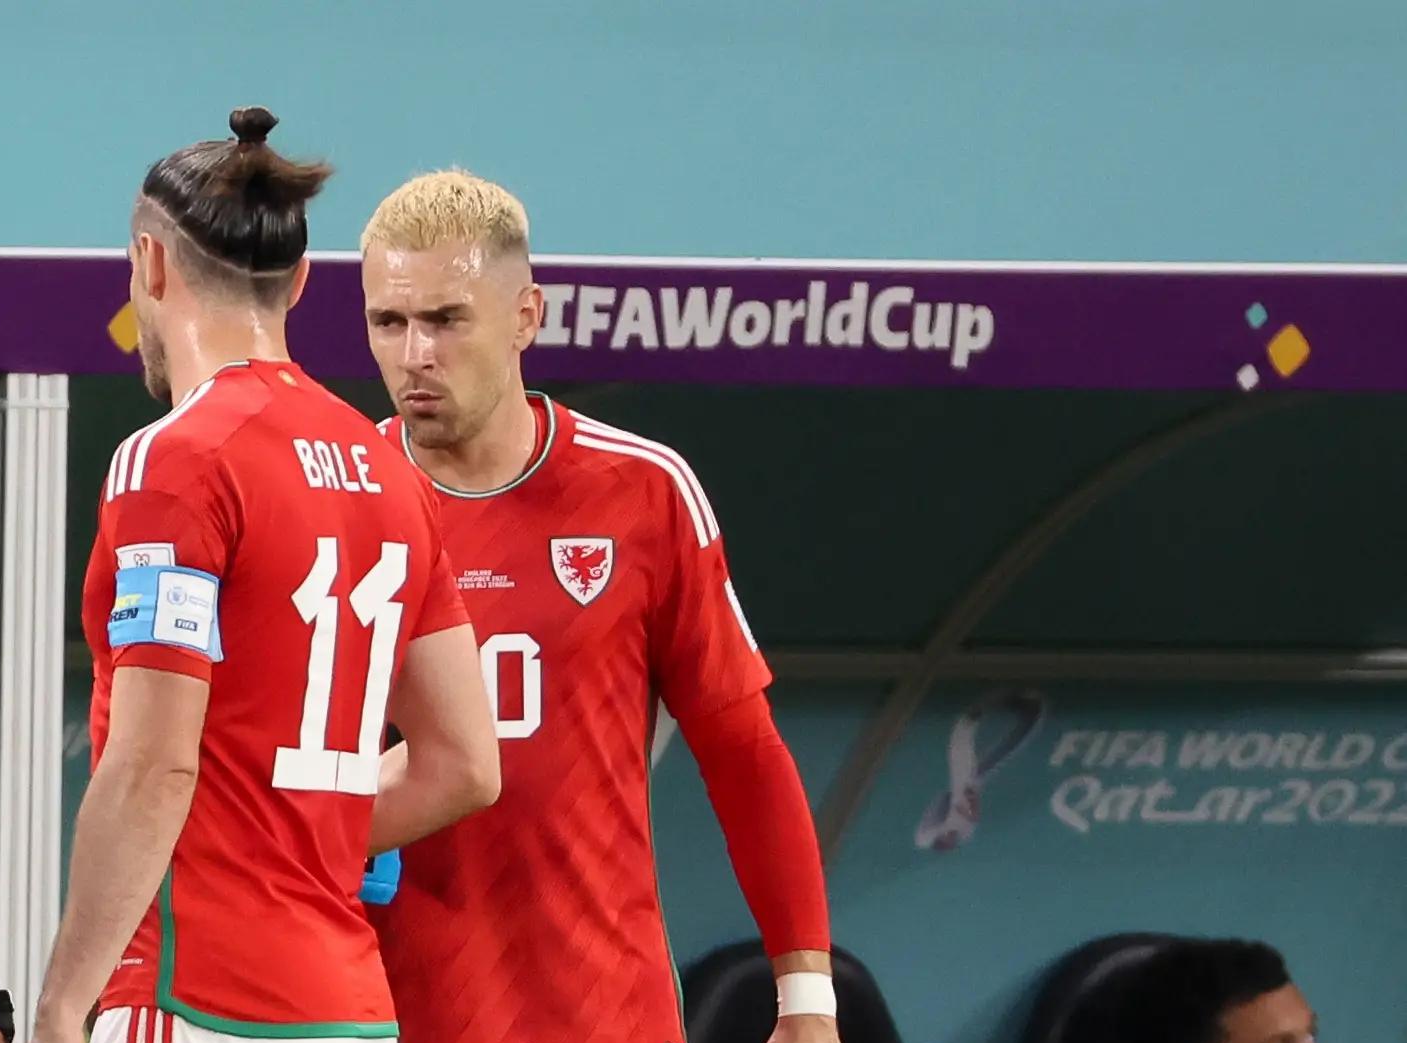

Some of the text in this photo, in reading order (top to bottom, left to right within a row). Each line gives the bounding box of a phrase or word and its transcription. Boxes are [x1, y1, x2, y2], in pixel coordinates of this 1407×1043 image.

[536, 280, 994, 369] IFAWorldCup
[292, 438, 382, 494] BALE
[176, 620, 197, 630] FIFA
[272, 536, 409, 796] 11
[479, 633, 542, 739] 0
[1049, 731, 1169, 768] FIFA
[1177, 731, 1375, 771] WORLD
